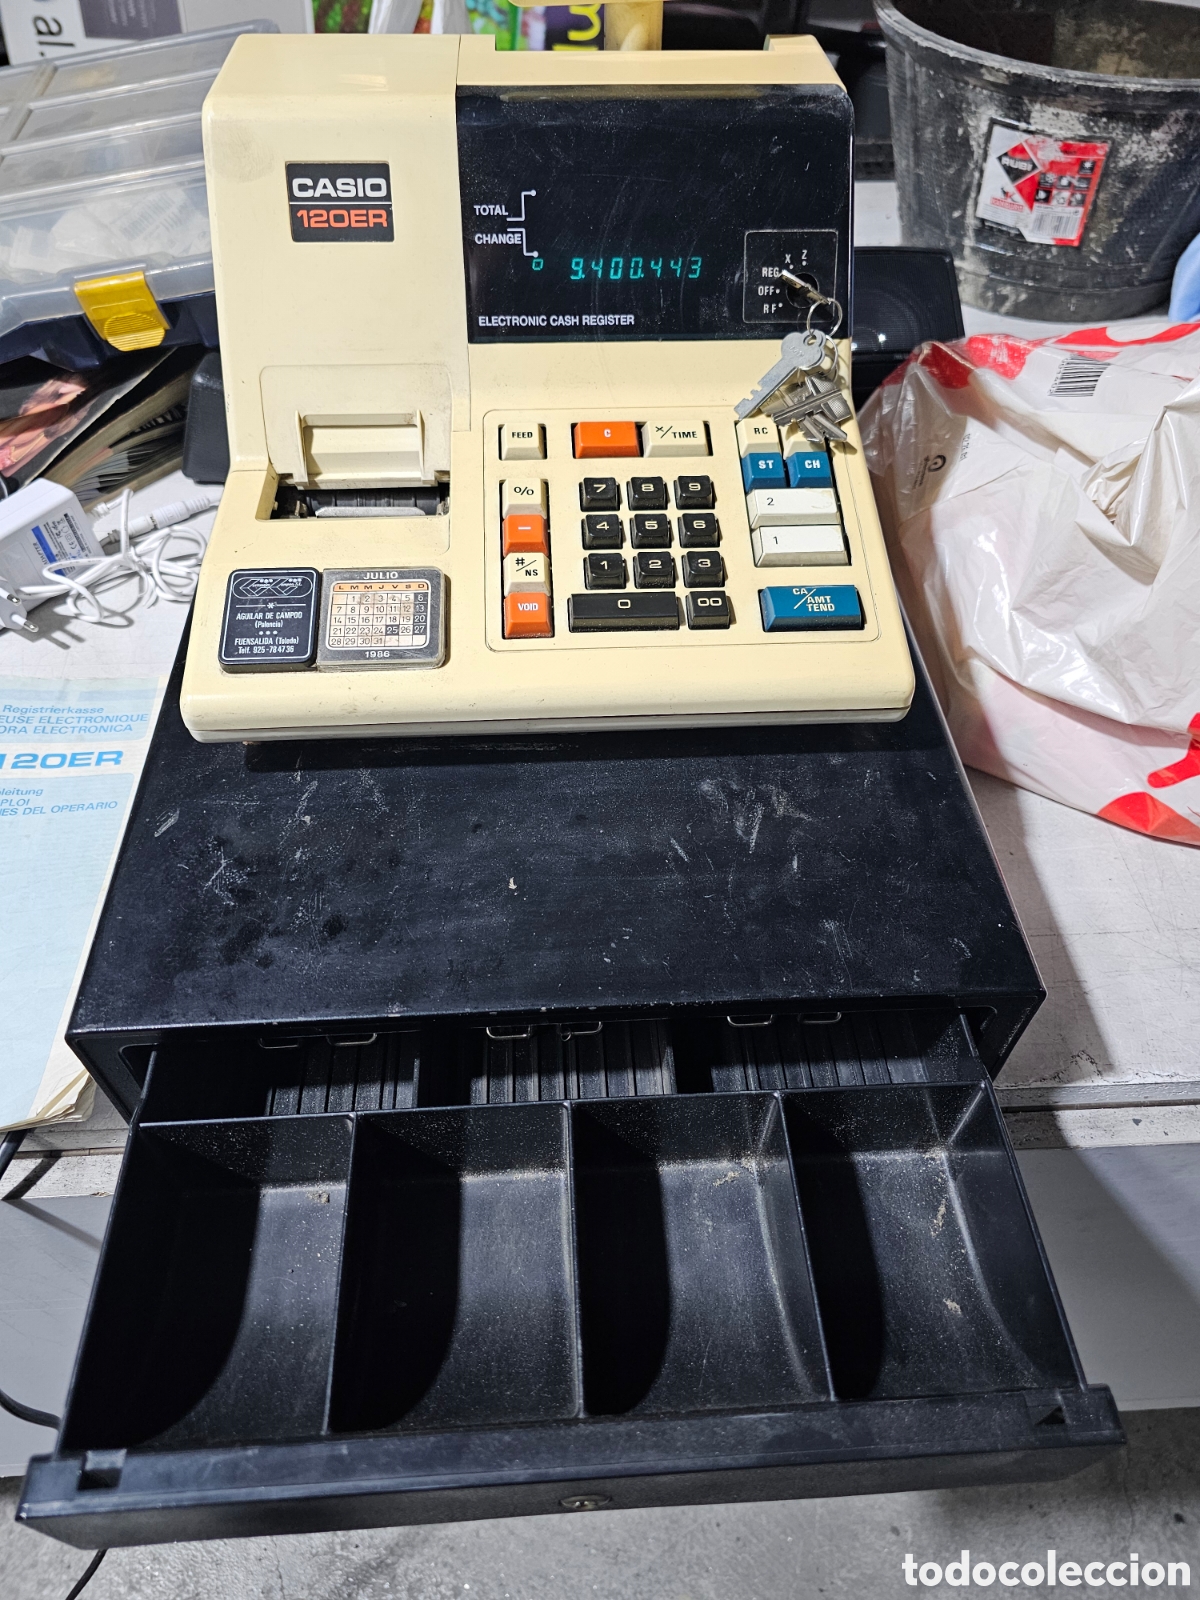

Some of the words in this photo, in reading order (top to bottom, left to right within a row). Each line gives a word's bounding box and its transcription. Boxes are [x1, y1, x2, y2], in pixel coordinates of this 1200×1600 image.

[1001, 155, 1034, 171] RUBI
[292, 178, 387, 198] CASIO
[474, 204, 508, 216] TOTAL
[296, 210, 388, 228] 120ER
[474, 234, 522, 244] CHANGE
[784, 254, 792, 264] X
[801, 249, 808, 260] Z
[762, 266, 780, 278] REG
[758, 286, 774, 296] OFF
[478, 315, 548, 327] ELECTRONIC
[550, 315, 580, 326] CASH
[582, 314, 635, 326] REGISTER
[604, 428, 612, 438] C
[753, 427, 768, 435] RC
[758, 460, 774, 469] ST
[804, 459, 821, 469] CH
[593, 484, 606, 493] 7
[641, 484, 654, 492] 8
[688, 482, 701, 491] 9
[766, 497, 775, 506] 2
[596, 522, 610, 530] 4
[644, 521, 658, 530] 5
[692, 520, 706, 529] 6
[773, 536, 779, 545] 1
[600, 560, 608, 570] 1
[648, 560, 662, 569] 2
[698, 558, 711, 568] 3
[617, 599, 632, 609] 0
[697, 598, 722, 607] 00
[807, 596, 832, 604] AMT
[518, 602, 539, 612] VOID
[806, 604, 835, 612] TEND
[236, 612, 263, 620] AGUILAR
[234, 638, 273, 646] FUENSALIDA
[2, 704, 104, 715] Registrierkasse
[38, 714, 149, 725] ELECTRONIQUE
[33, 724, 134, 734] ELECTRONICA
[0, 788, 44, 796] leitung
[22, 806, 46, 816] DEL
[50, 800, 118, 814] OPERARIO
